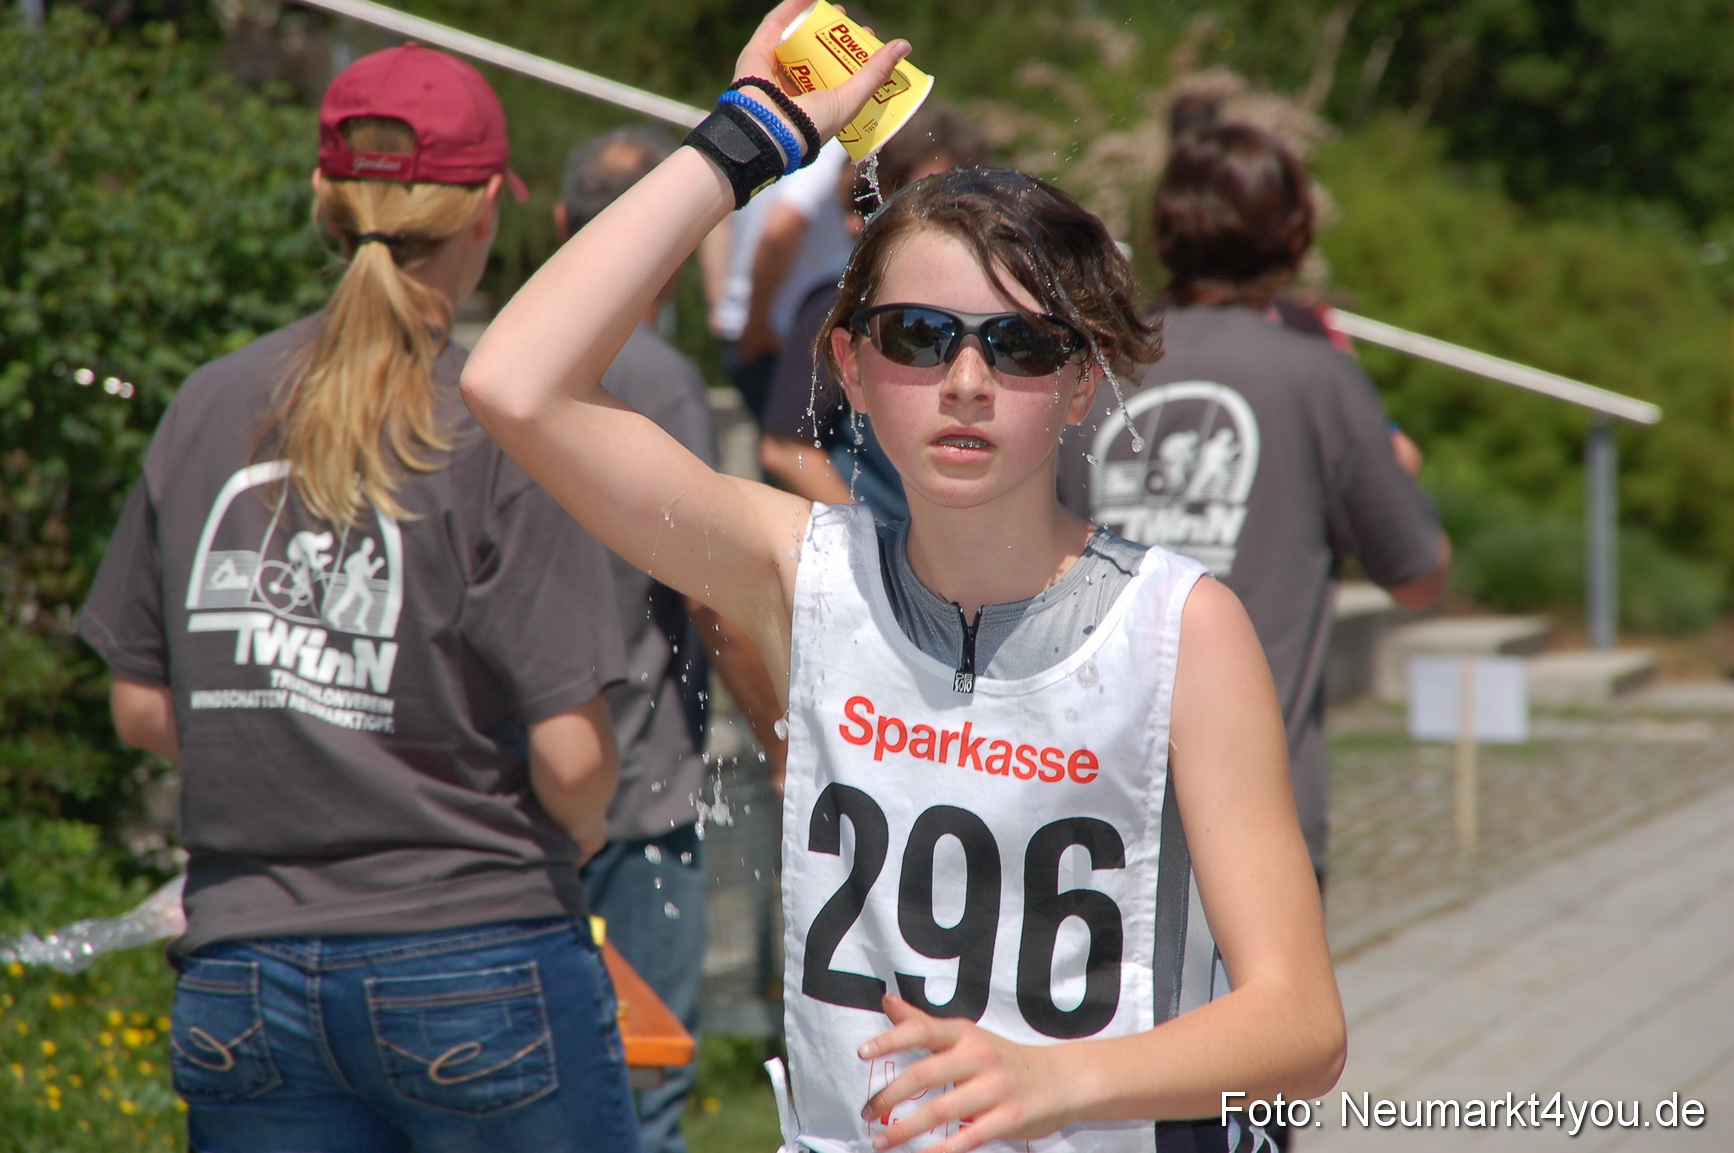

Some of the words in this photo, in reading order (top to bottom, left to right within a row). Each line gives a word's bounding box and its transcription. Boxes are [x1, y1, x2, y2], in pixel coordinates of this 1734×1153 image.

[820, 31, 841, 54] Premium
[839, 695, 1099, 784] Sparkasse
[802, 782, 1126, 1040] 296
